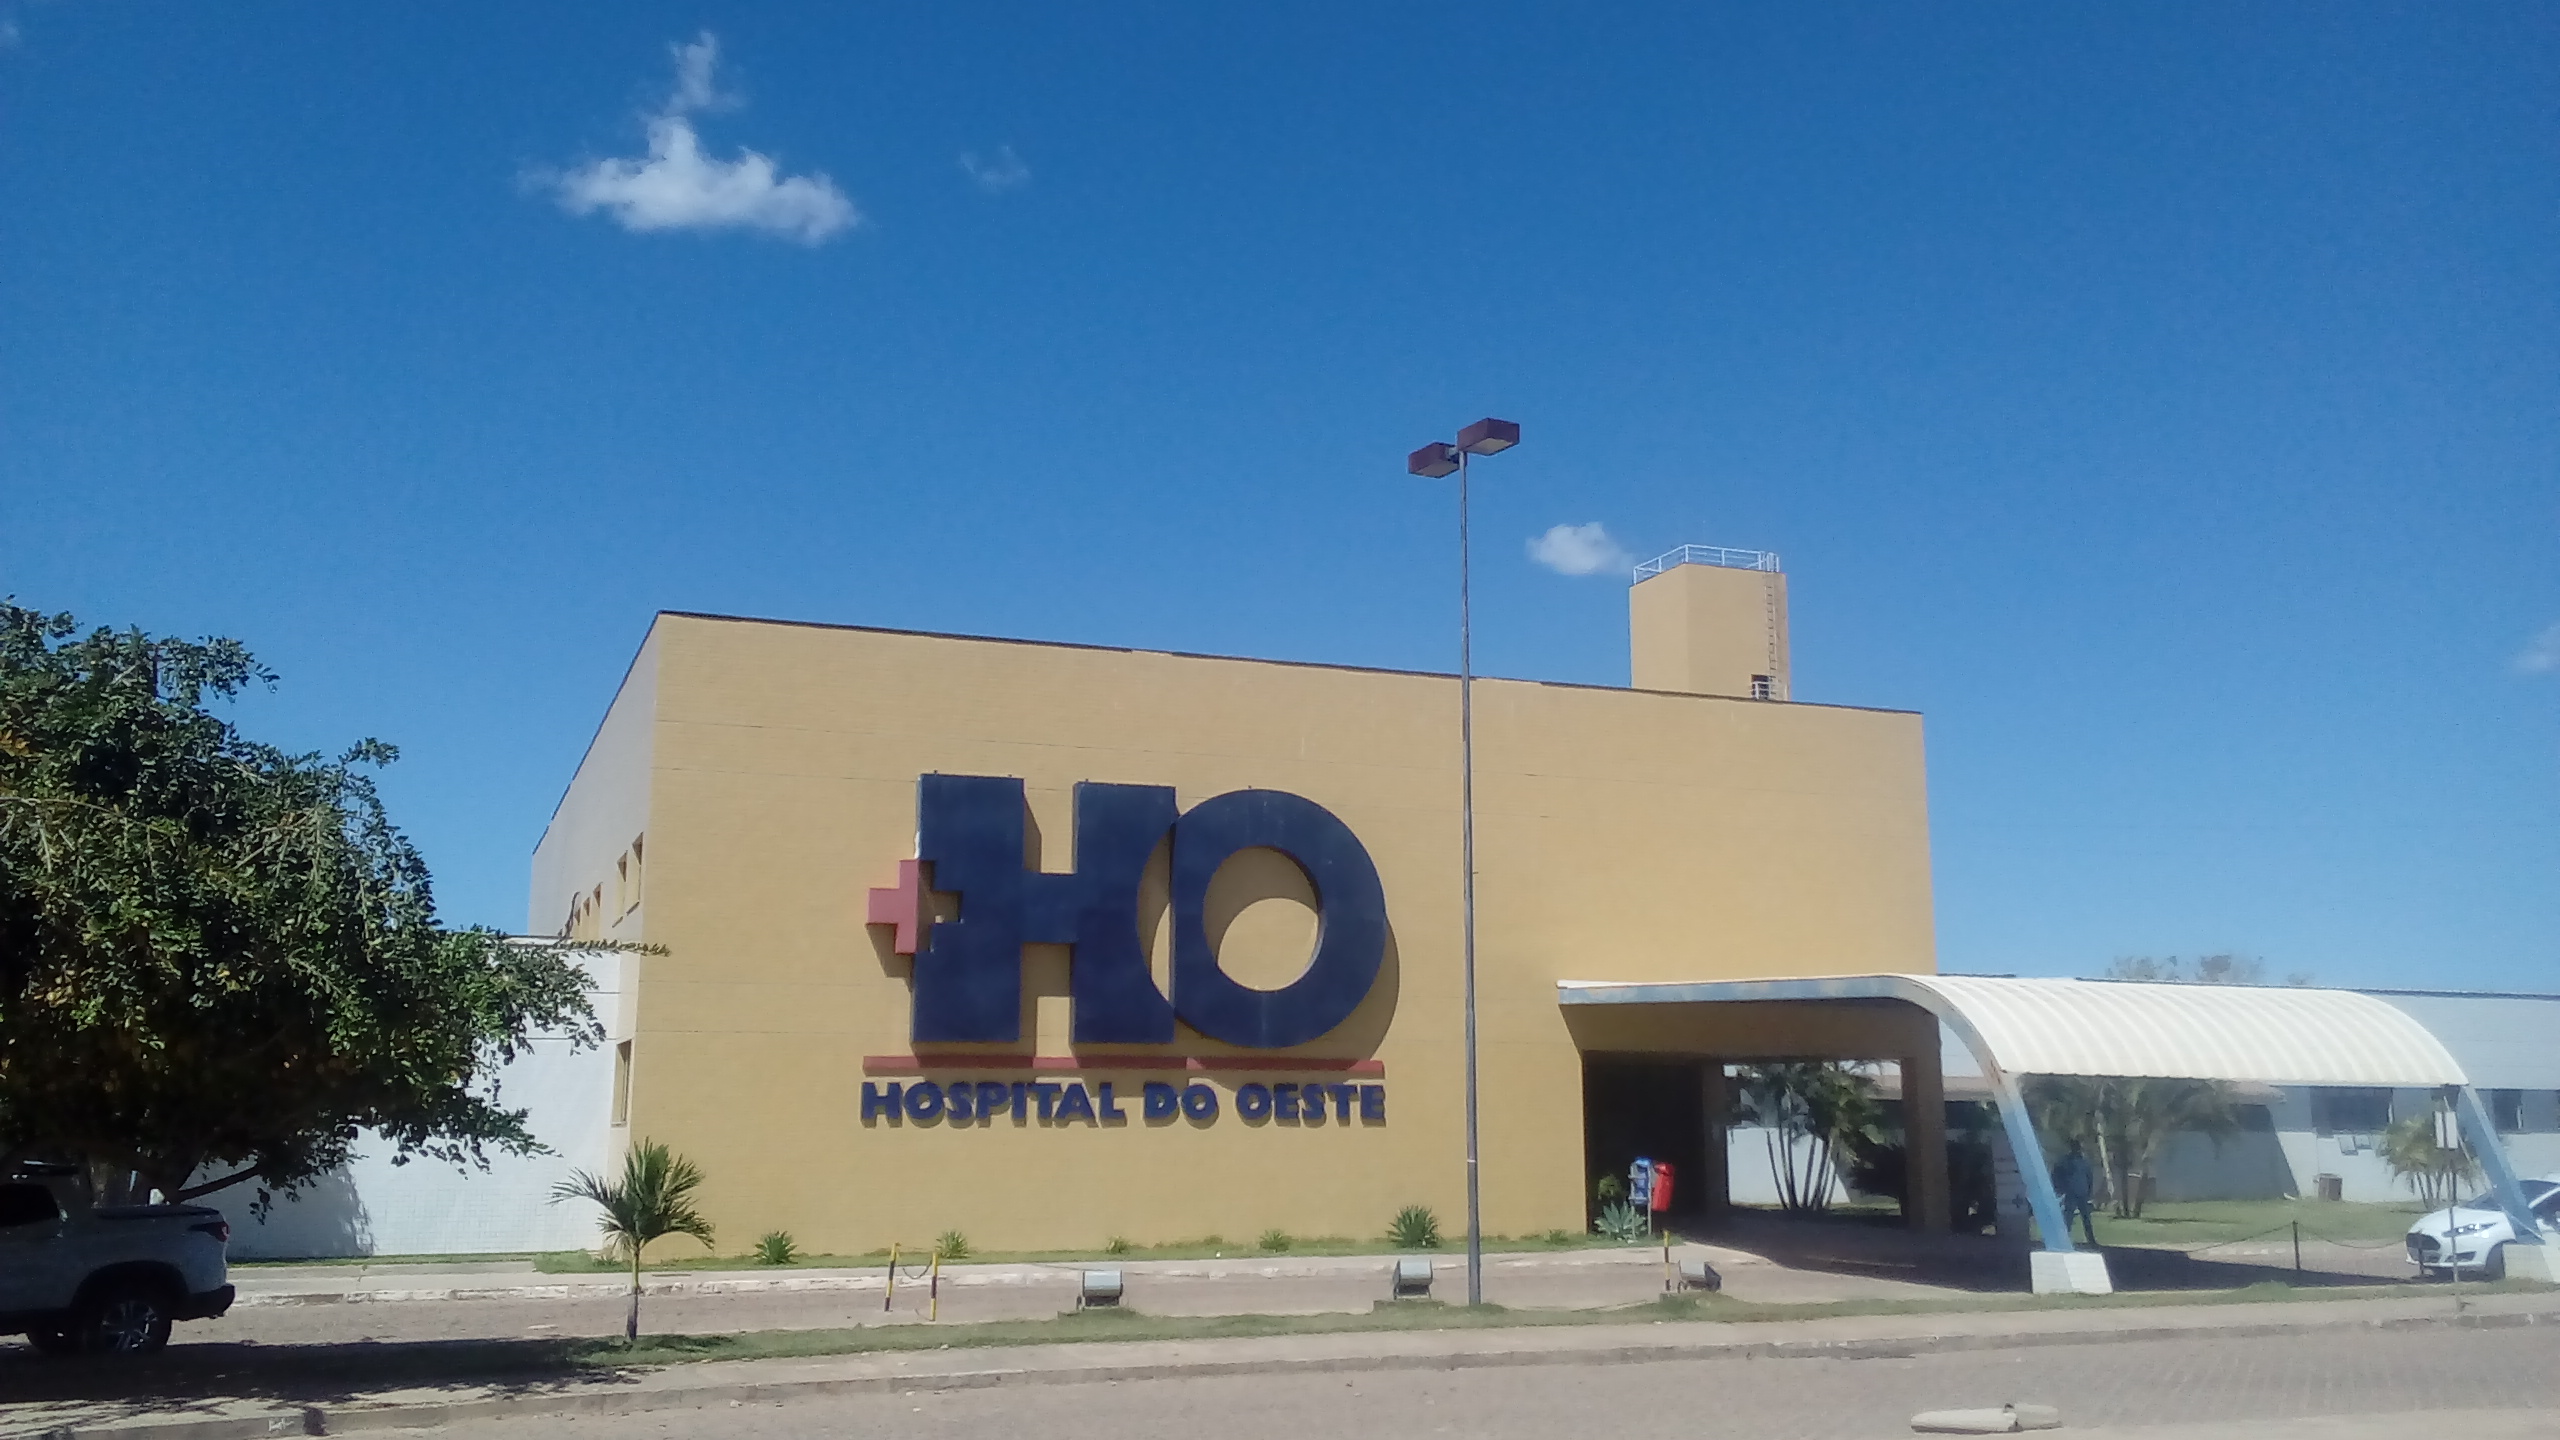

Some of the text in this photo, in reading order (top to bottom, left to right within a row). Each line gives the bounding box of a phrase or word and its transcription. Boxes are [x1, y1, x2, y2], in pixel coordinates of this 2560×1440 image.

[912, 773, 1386, 1049] HO
[861, 1081, 1386, 1121] HOSPITAL DO OESTE
